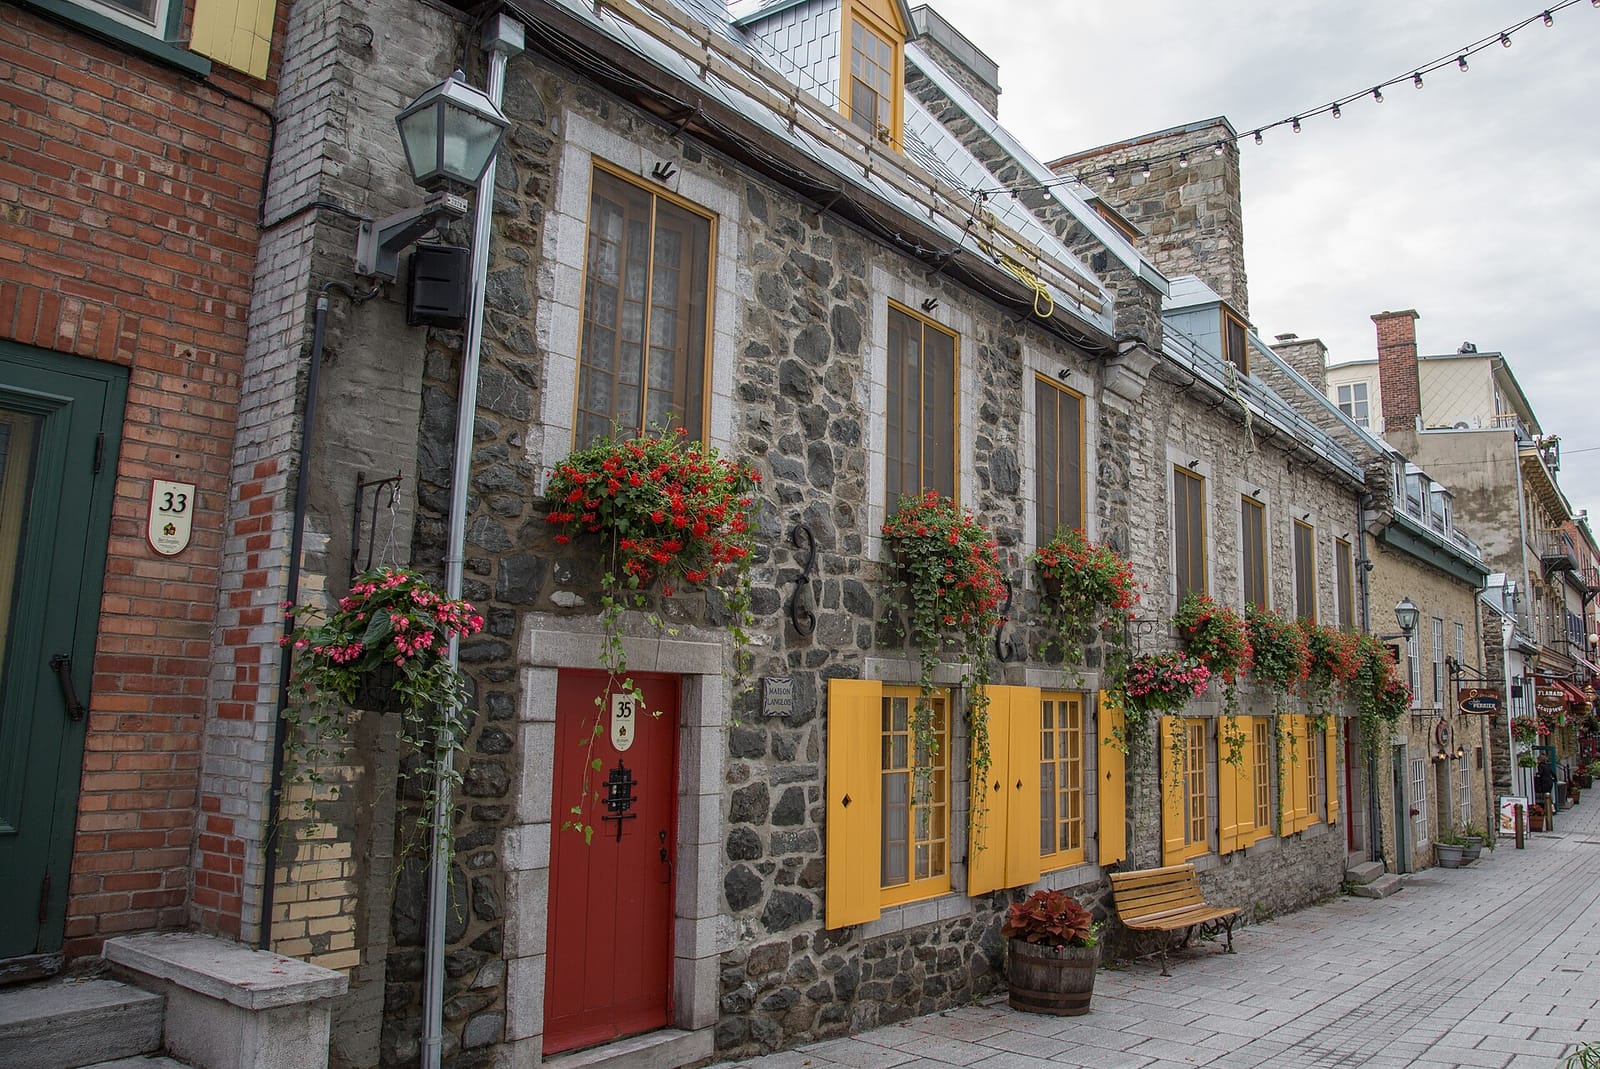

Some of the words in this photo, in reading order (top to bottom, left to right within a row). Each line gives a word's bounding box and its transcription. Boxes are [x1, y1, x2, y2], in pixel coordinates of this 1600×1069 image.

[159, 492, 187, 512] 33
[769, 687, 791, 695] MAISON
[616, 701, 632, 718] 35
